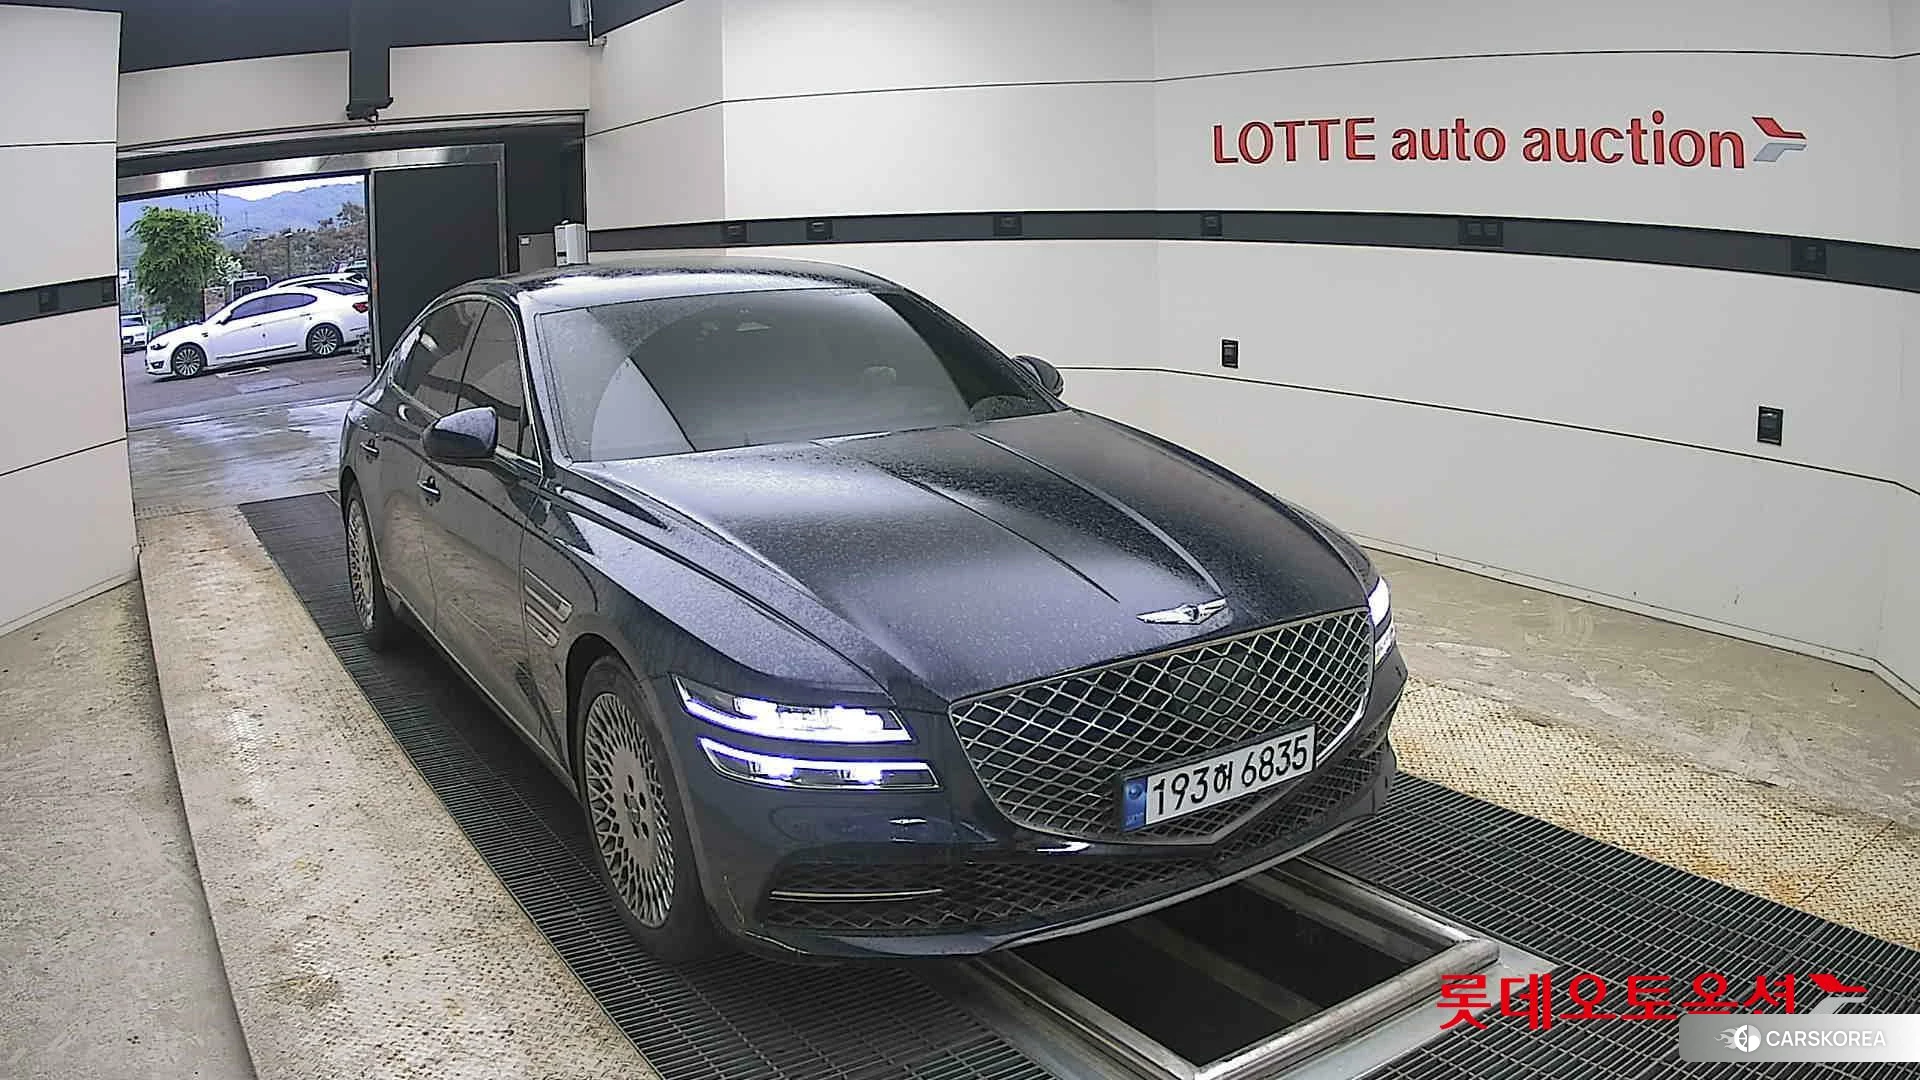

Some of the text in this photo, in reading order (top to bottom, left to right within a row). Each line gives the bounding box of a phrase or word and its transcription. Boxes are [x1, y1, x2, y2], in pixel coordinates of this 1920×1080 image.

[1212, 110, 1746, 168] LOTTE auto auction
[1152, 734, 1309, 815] 193허 6835
